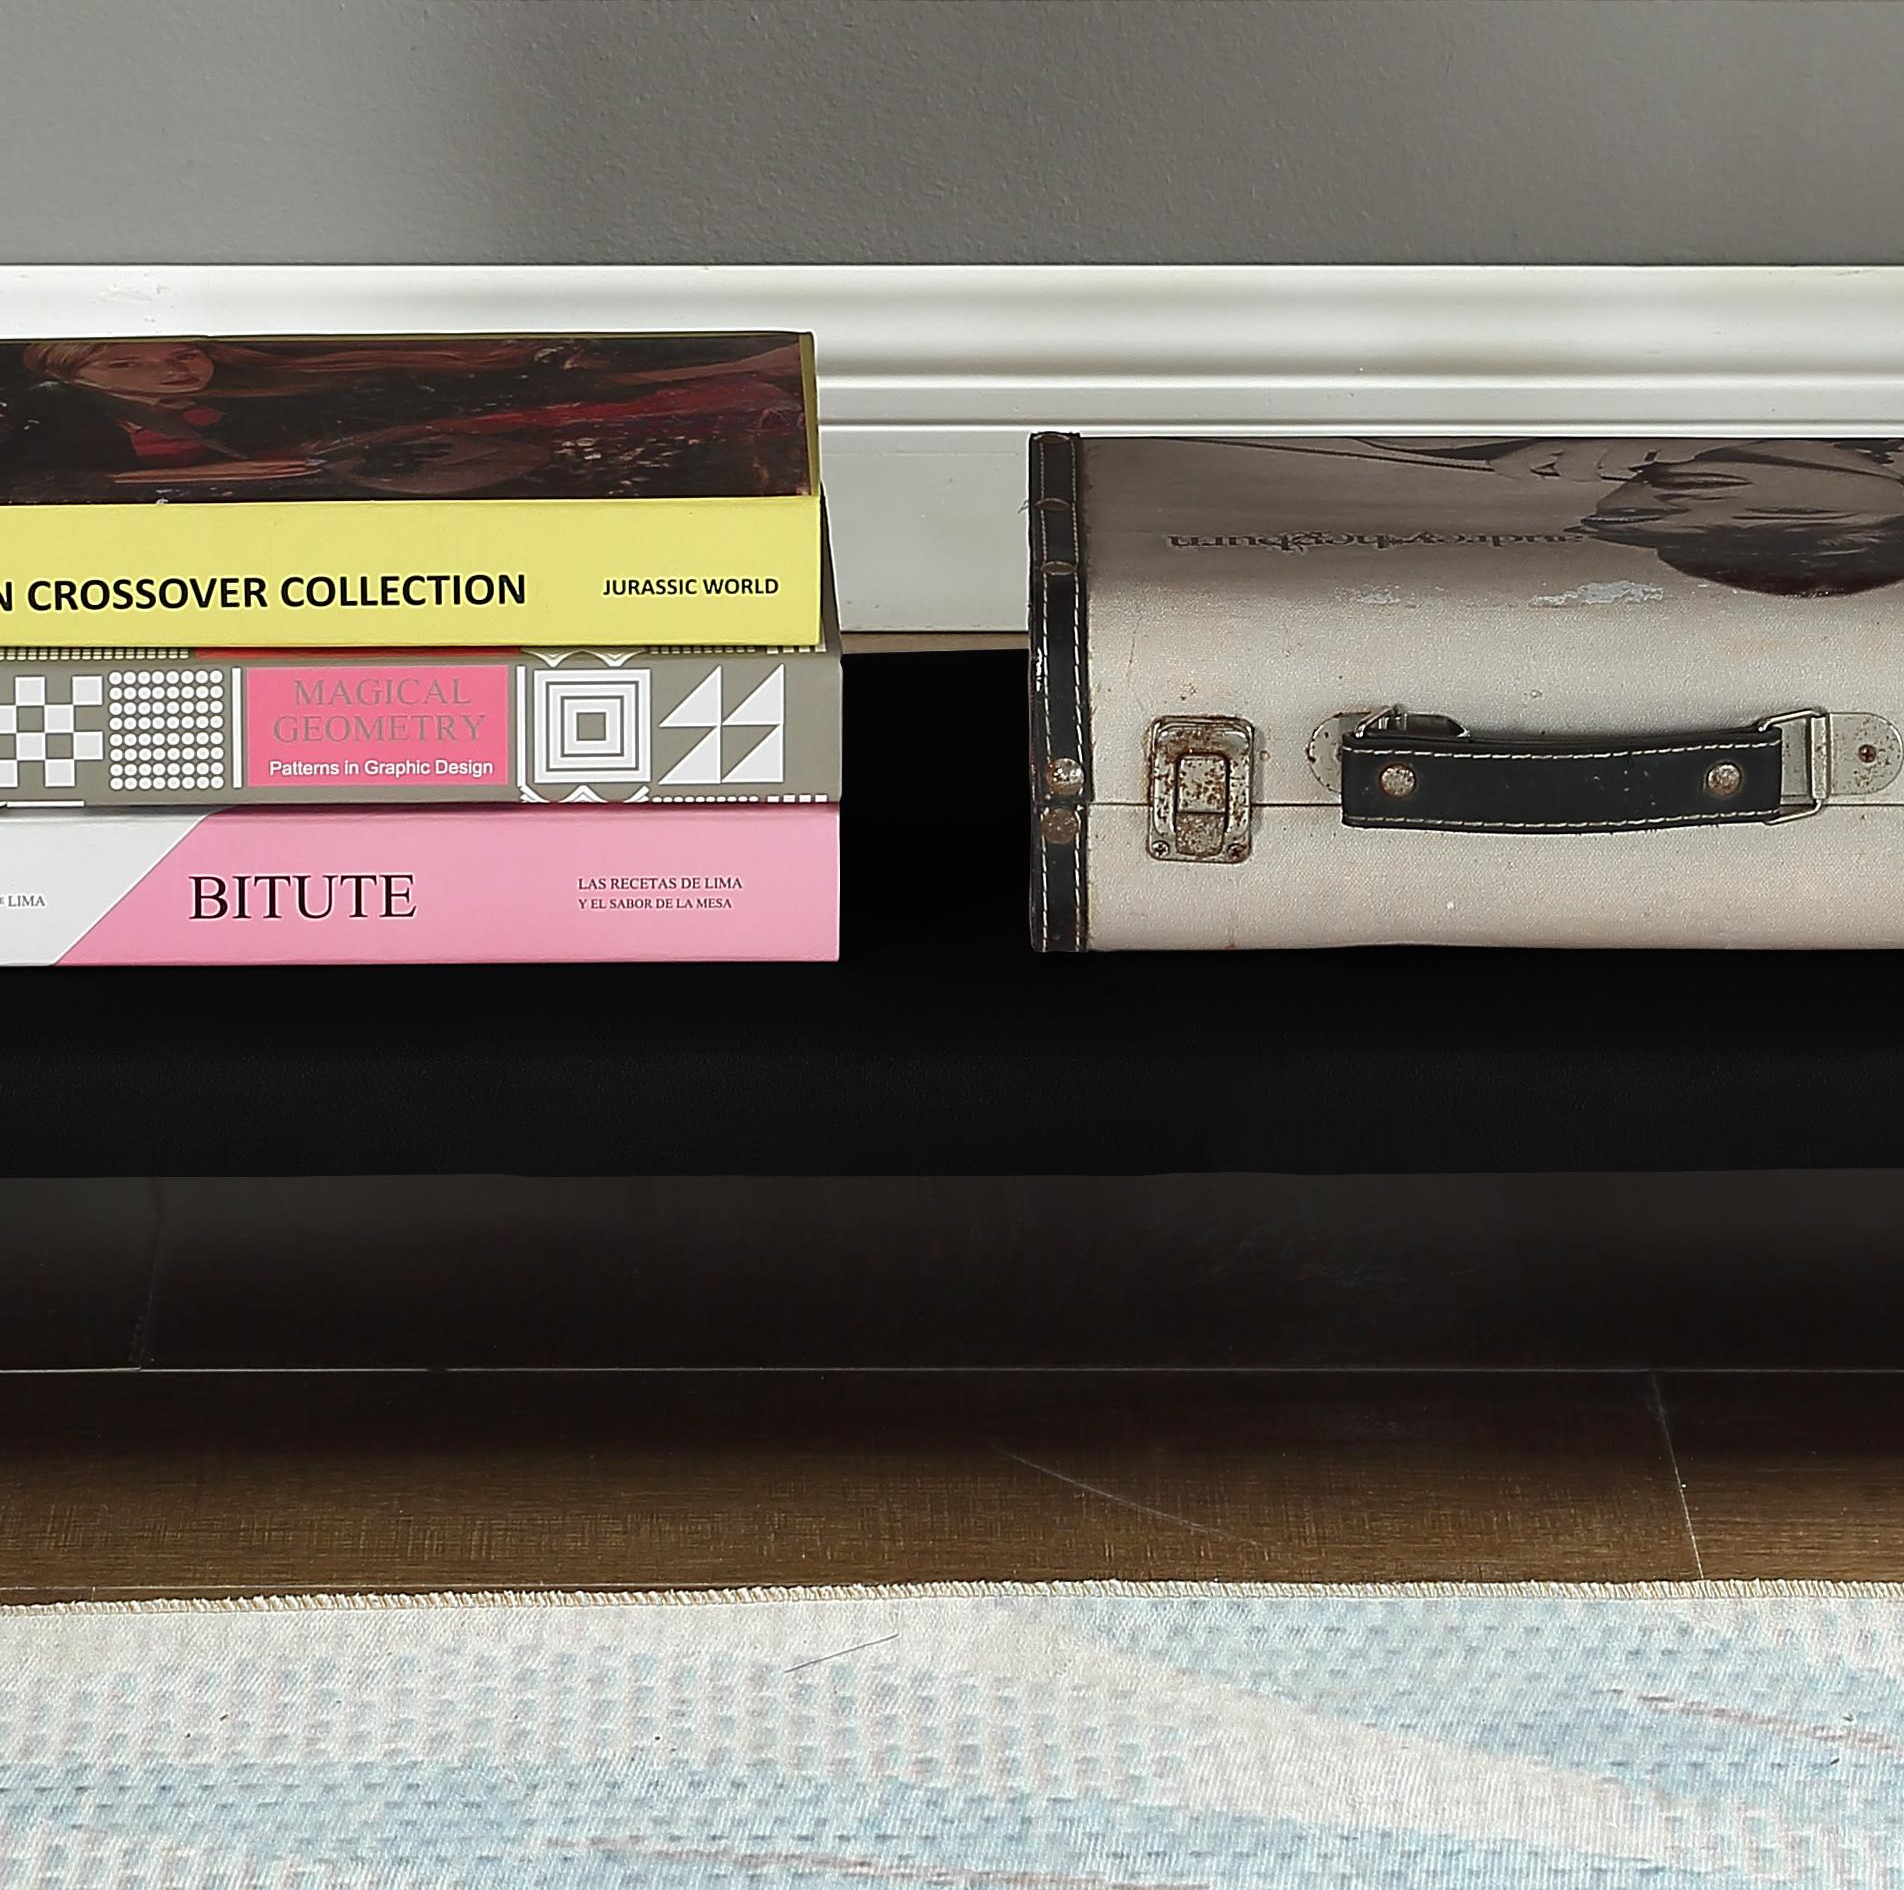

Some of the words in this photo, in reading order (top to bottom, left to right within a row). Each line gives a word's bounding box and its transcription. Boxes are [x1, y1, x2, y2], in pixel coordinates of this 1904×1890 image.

[27, 576, 267, 610] CROSSOVER
[280, 574, 526, 607] COLLECTION
[603, 579, 698, 596] JURASSIC
[703, 578, 778, 595] WORLD
[294, 678, 472, 705] MAGICAL
[273, 714, 487, 743] GEOMETRY
[269, 760, 339, 776] Patterns
[345, 760, 359, 775] in
[364, 759, 431, 777] Graphic
[435, 759, 493, 777] Design
[578, 878, 606, 890] LAS
[610, 878, 677, 890] RECETAS
[681, 877, 701, 889] DE
[704, 877, 743, 889] LIMA
[8, 895, 46, 907] LIMA
[188, 874, 417, 919] BITUTE
[578, 898, 587, 909] Y
[591, 898, 606, 909] EL
[610, 898, 652, 909] SABOR
[656, 898, 673, 909] DE
[676, 898, 693, 909] LA
[696, 898, 732, 909] MESA
